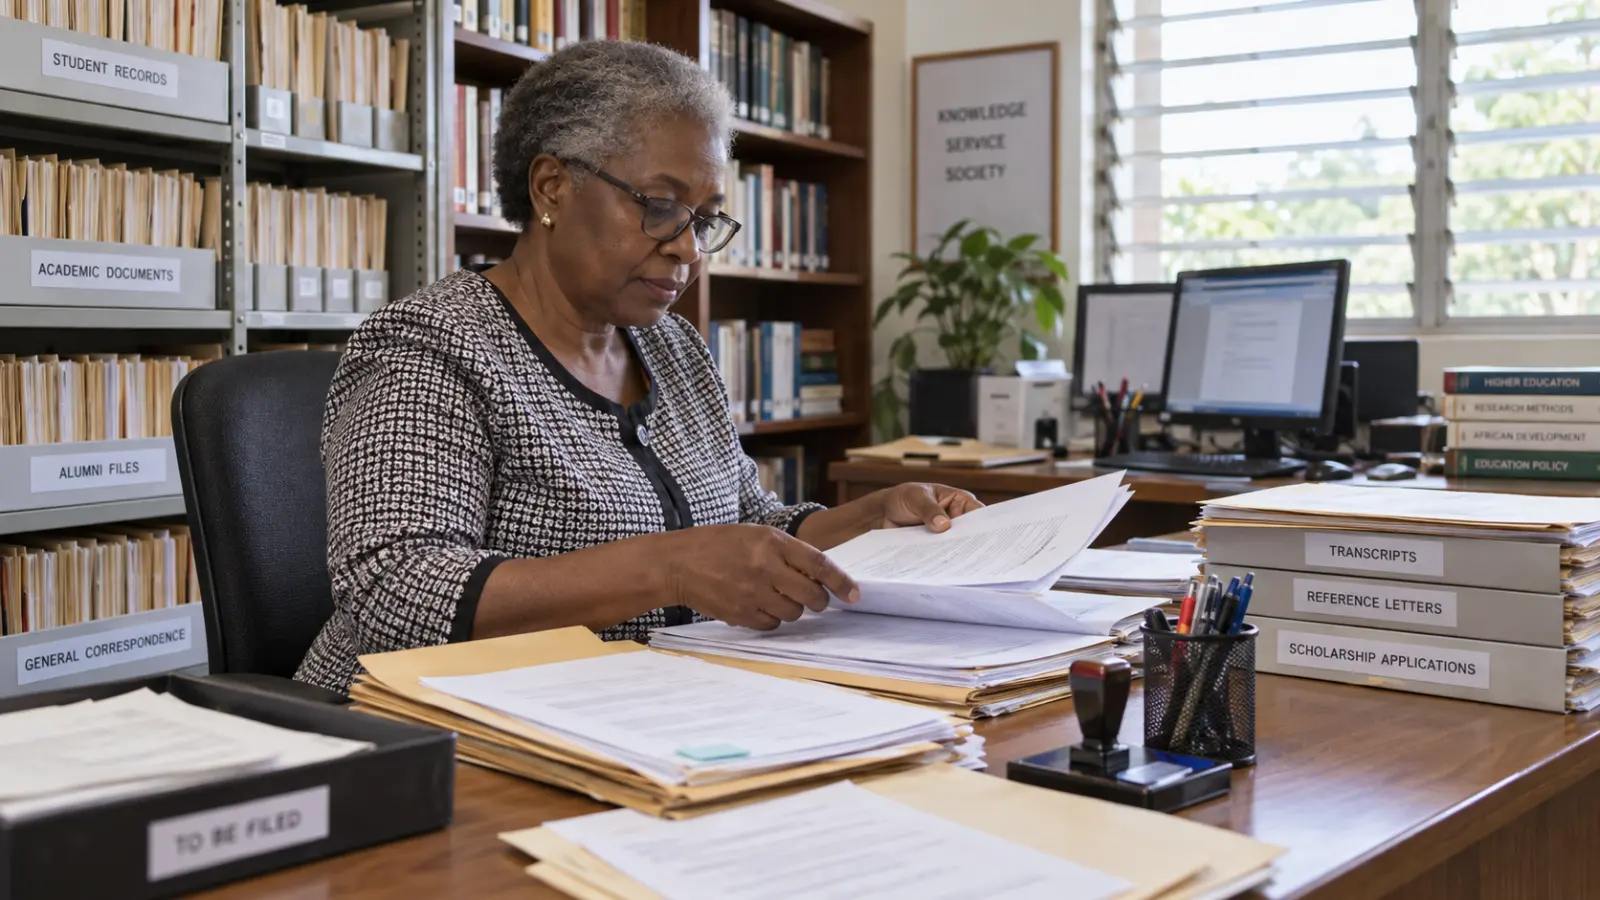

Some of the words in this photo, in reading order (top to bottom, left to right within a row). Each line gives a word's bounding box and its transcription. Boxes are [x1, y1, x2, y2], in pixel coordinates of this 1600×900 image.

[52, 53, 108, 75] STUDENT
[114, 64, 168, 86] RECORDS
[937, 101, 1028, 124] KNOWLEDGE
[945, 133, 1006, 153] SERVICE
[945, 163, 1006, 182] SOCIETY
[38, 262, 100, 279] ACADEMIC
[106, 266, 174, 282] DOCUMENTS
[1484, 377, 1520, 388] HIGHER
[1523, 377, 1580, 388] EDUCATION
[1474, 403, 1524, 414] RESEARCH
[1526, 404, 1574, 414] METHODS
[1474, 430, 1514, 441] AFRICAN
[1516, 431, 1587, 442] DEVELOPMENT
[59, 464, 103, 480] ALUMNI
[108, 460, 140, 475] FILES
[1474, 458, 1530, 470] EDUCATION
[1532, 460, 1569, 472] POLICY
[1328, 544, 1418, 564] TRANSCRIPTS
[1306, 590, 1380, 610] REFERENCE
[1385, 596, 1443, 615] LETTERS
[24, 649, 80, 672] GENERAL
[85, 627, 187, 660] CORRESPONDENCE
[1288, 642, 1377, 664] SCHOLARSHIP
[1380, 652, 1477, 676] APPLICATIONS
[174, 830, 202, 856] TO
[211, 822, 239, 846] BE
[245, 808, 303, 840] FILED
